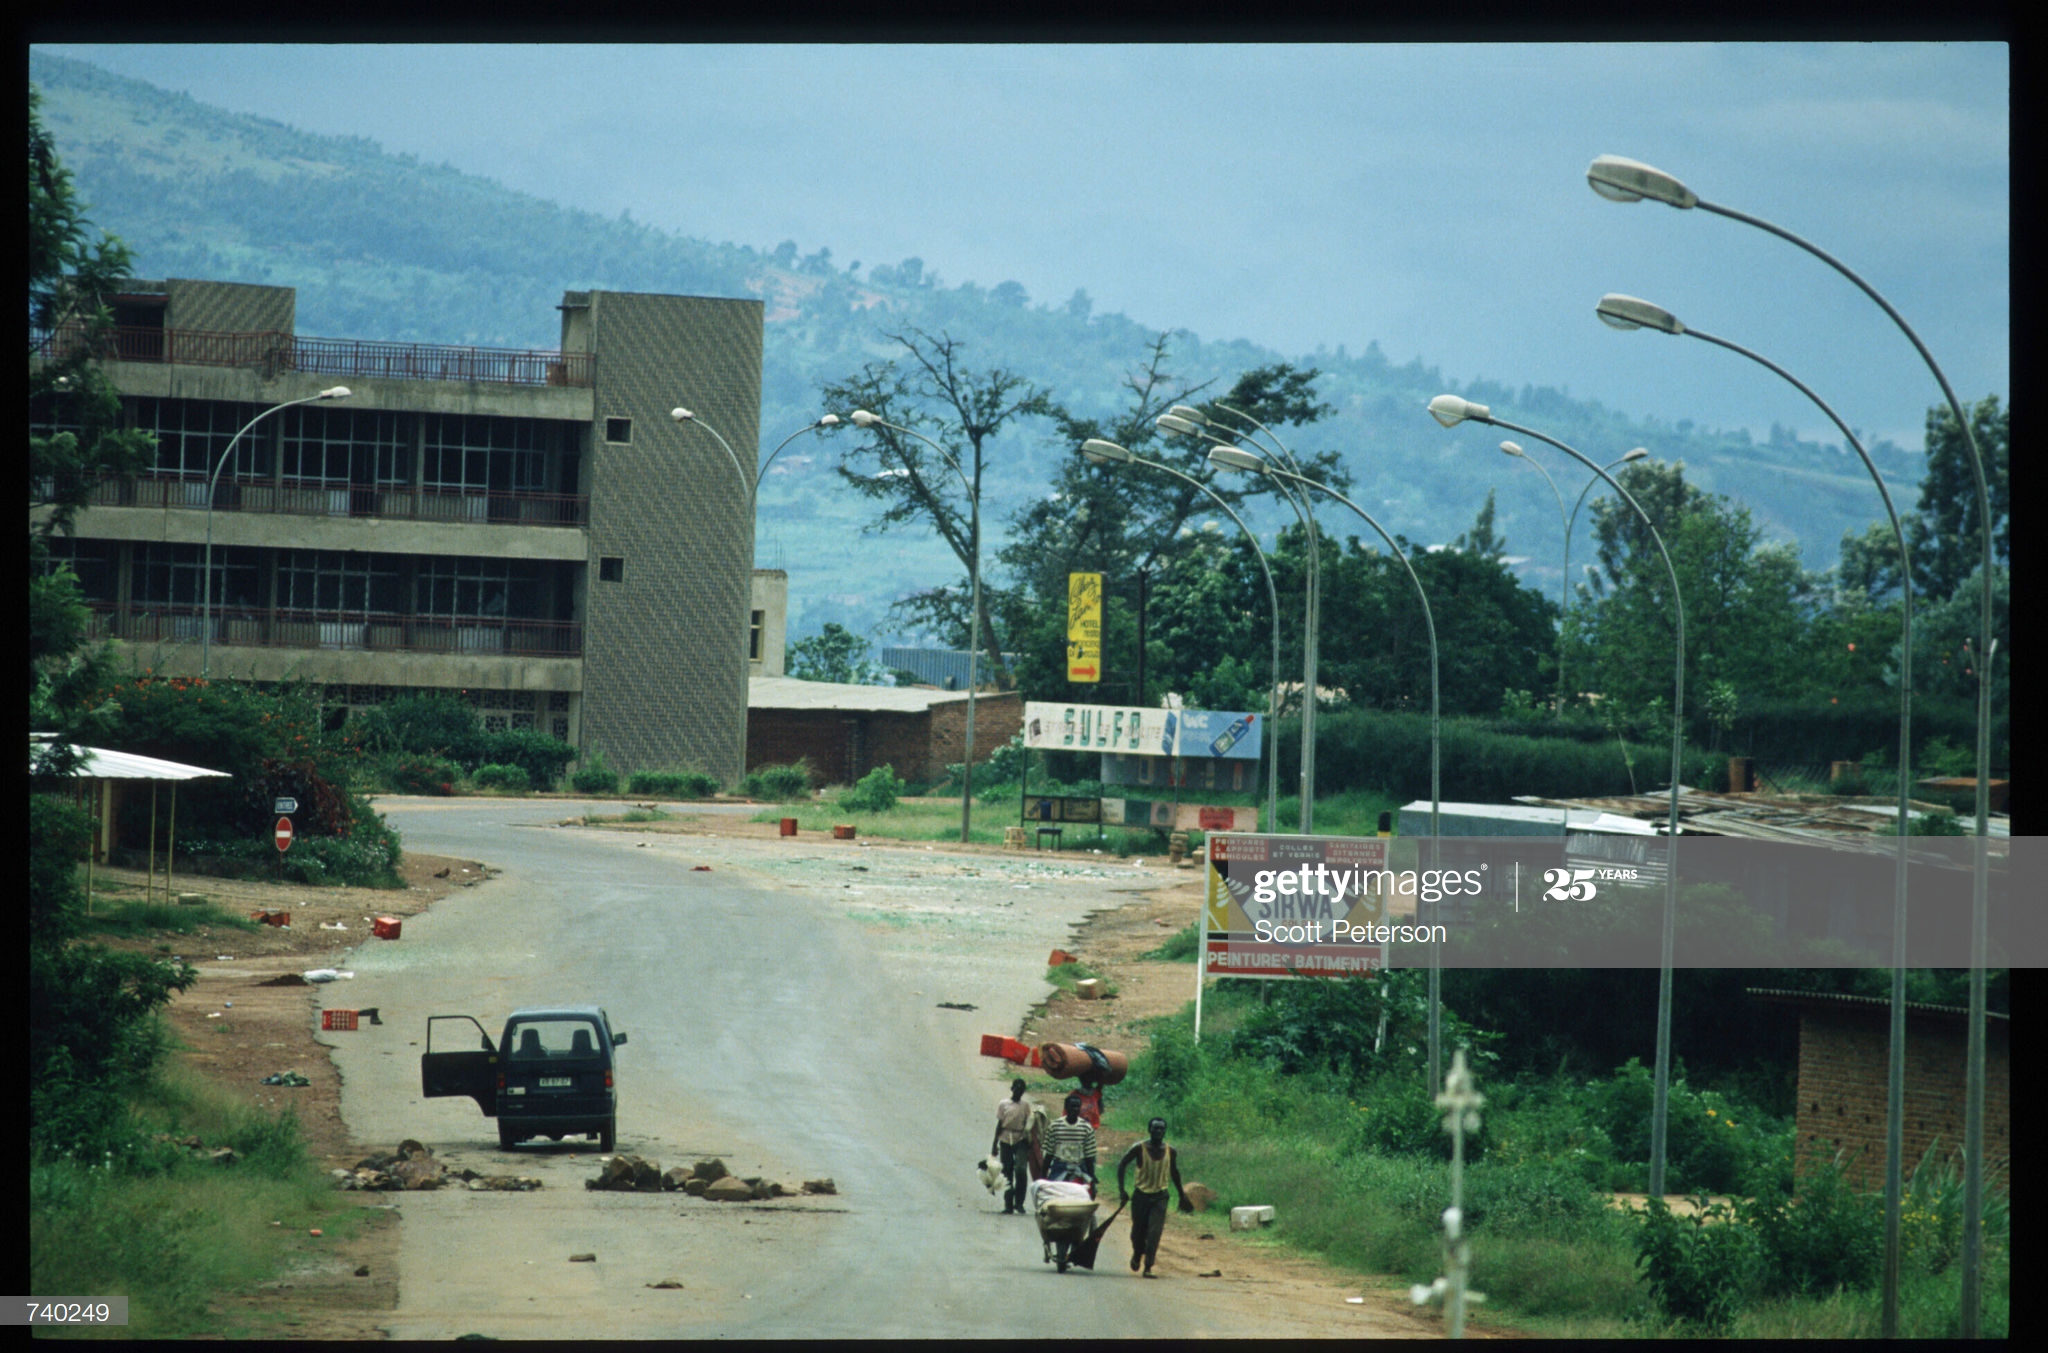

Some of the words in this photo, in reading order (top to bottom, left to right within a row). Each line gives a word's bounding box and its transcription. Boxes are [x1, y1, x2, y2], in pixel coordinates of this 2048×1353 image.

[1080, 619, 1099, 629] HOTEL
[1182, 712, 1209, 729] WC
[1063, 708, 1141, 749] SULFO
[1215, 838, 1265, 846] PEINTURES
[1329, 842, 1381, 850] SANITAIRES
[1215, 852, 1265, 860] VEHICULES
[1207, 951, 1291, 968] PEINTURES
[1295, 953, 1380, 971] BATIMENTS
